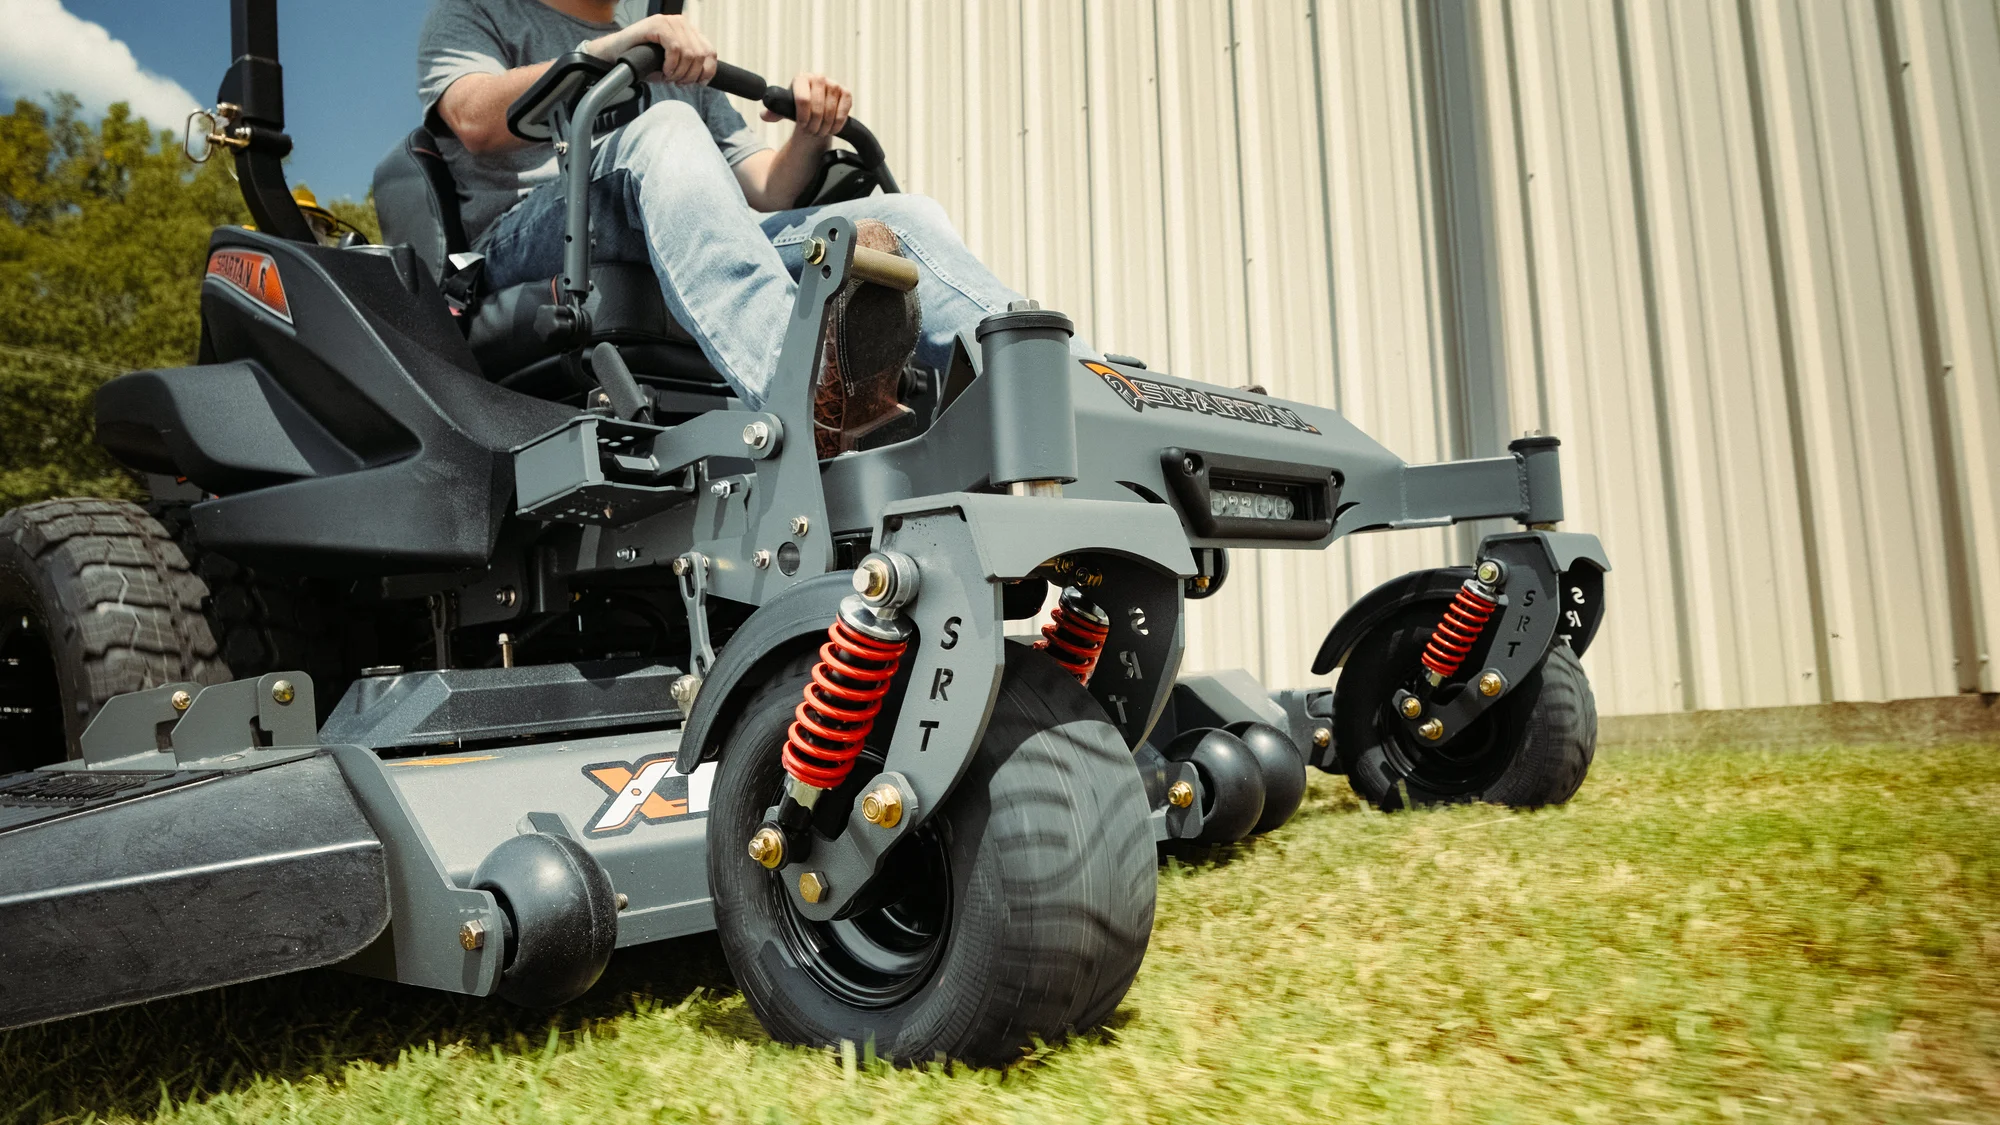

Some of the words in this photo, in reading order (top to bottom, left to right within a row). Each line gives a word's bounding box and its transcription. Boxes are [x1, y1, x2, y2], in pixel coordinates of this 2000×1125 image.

[216, 254, 255, 289] SPARTAN
[1130, 378, 1310, 431] SPARTAN
[1507, 589, 1536, 658] SRT
[919, 616, 962, 752] SRT
